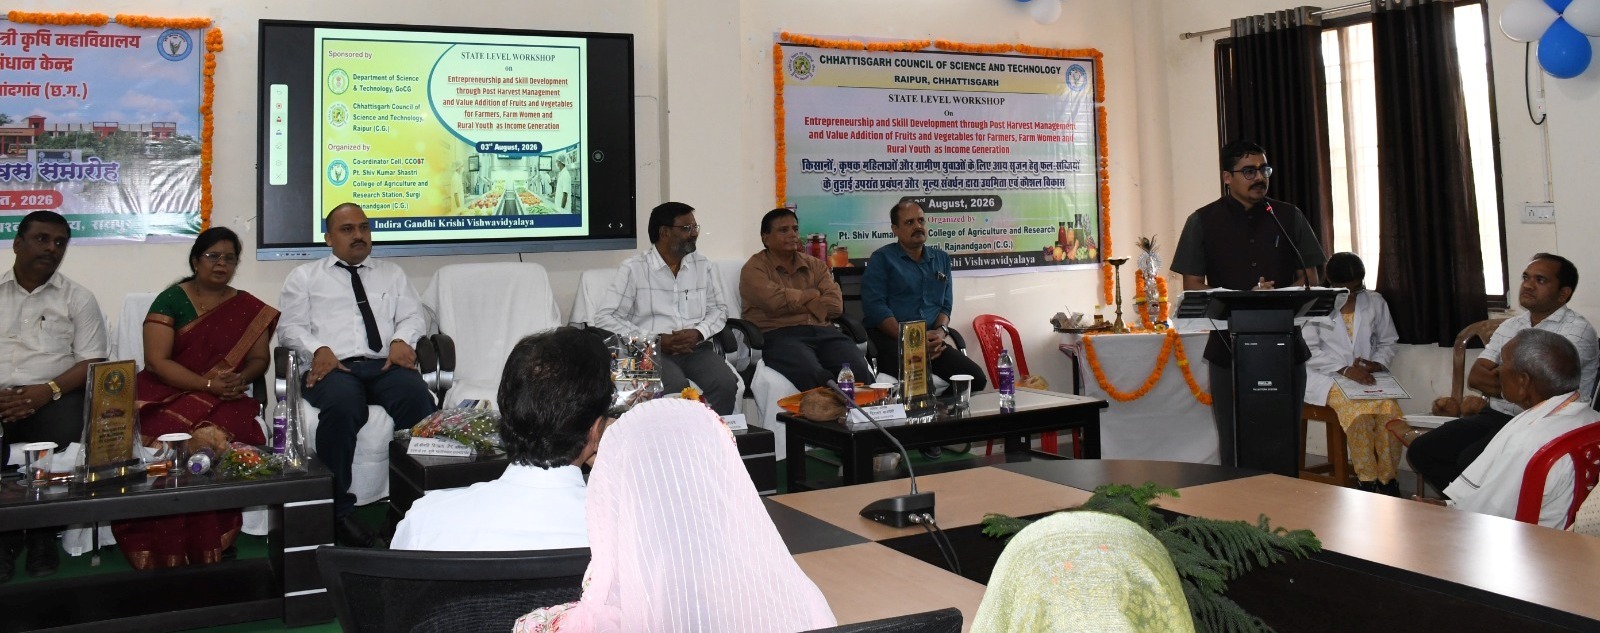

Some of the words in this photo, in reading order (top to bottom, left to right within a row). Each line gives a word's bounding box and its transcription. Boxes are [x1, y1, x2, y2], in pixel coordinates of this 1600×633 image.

[0, 28, 18, 46] त्री
[20, 28, 52, 52] कृषि
[54, 30, 141, 48] महाविद्यालय
[328, 50, 364, 58] Sponsored
[512, 54, 556, 62] WORKSHOP
[39, 54, 74, 72] केन्द्र
[820, 55, 892, 67] CHHATTISGARH
[894, 59, 934, 68] COUNCIL
[936, 60, 947, 69] OF
[950, 61, 986, 71] SCIENCE
[988, 64, 1005, 72] AND
[1008, 64, 1061, 74] TECHNOLOGY
[353, 74, 387, 82] Department
[448, 76, 501, 84] Entrepreneurship
[530, 78, 568, 86] Development
[894, 76, 930, 85] RAIPUR,
[932, 77, 999, 86] CHHATTISGARH
[44, 82, 88, 100] (छ.ग.)
[456, 87, 481, 95] through
[522, 88, 560, 96] Management
[540, 100, 573, 108] Vegetables
[888, 94, 917, 103] STATE
[921, 95, 951, 104] LEVEL
[953, 96, 1005, 105] WORKSHOP
[353, 103, 390, 111] Chhattisgarh
[804, 117, 874, 128] Entrepreneurship
[876, 118, 890, 127] and
[892, 118, 908, 127] Skill
[910, 119, 958, 129] Development
[960, 120, 988, 130] through
[990, 121, 1005, 129] Post
[1007, 121, 1033, 130] Harvest
[1034, 122, 1076, 131] Management
[809, 130, 824, 139] and
[826, 130, 848, 139] Value
[851, 131, 883, 140] Addition
[886, 131, 893, 140] of
[895, 132, 916, 140] Fruits
[919, 132, 932, 140] and
[934, 132, 973, 142] Vegetables
[976, 132, 985, 141] for
[987, 133, 1018, 142] Farmers,
[1062, 134, 1074, 142] and
[494, 144, 520, 152] August,
[887, 145, 906, 153] Rural
[909, 145, 930, 153] Youth
[945, 145, 970, 154] Income
[972, 145, 1009, 154] Generation
[38, 156, 119, 182] समारोह
[839, 160, 860, 174] कृषक
[862, 159, 898, 170] महिलाओं
[899, 159, 914, 170] और
[916, 159, 940, 170] ग्रामीण
[942, 159, 966, 173] युवाओं
[967, 159, 974, 170] के
[976, 159, 992, 170] लिए
[993, 161, 1008, 170] आय
[1010, 161, 1027, 173] सृजन
[1028, 159, 1039, 173] हेतु
[823, 177, 831, 189] के
[855, 177, 878, 188] उपरांत
[880, 177, 903, 188] प्रबंधन
[904, 177, 919, 188] और
[922, 180, 939, 191] मूल्य
[1008, 177, 1019, 187] एवं
[1043, 177, 1065, 187] विकास
[20, 194, 53, 206] 2026
[928, 199, 968, 210] August,
[970, 198, 995, 207] 2026
[375, 220, 401, 229] Indira
[404, 219, 436, 228] Gandhi
[438, 219, 465, 227] Krishi
[466, 218, 534, 228] Vishwavidyalaya
[852, 231, 869, 239] Shiv
[928, 229, 956, 238] College
[968, 227, 1007, 237] Agriculture
[945, 242, 991, 252] Rajnandgaon
[993, 241, 1013, 250] (C.G.)
[964, 254, 1035, 267] Vishwavidyalaya
